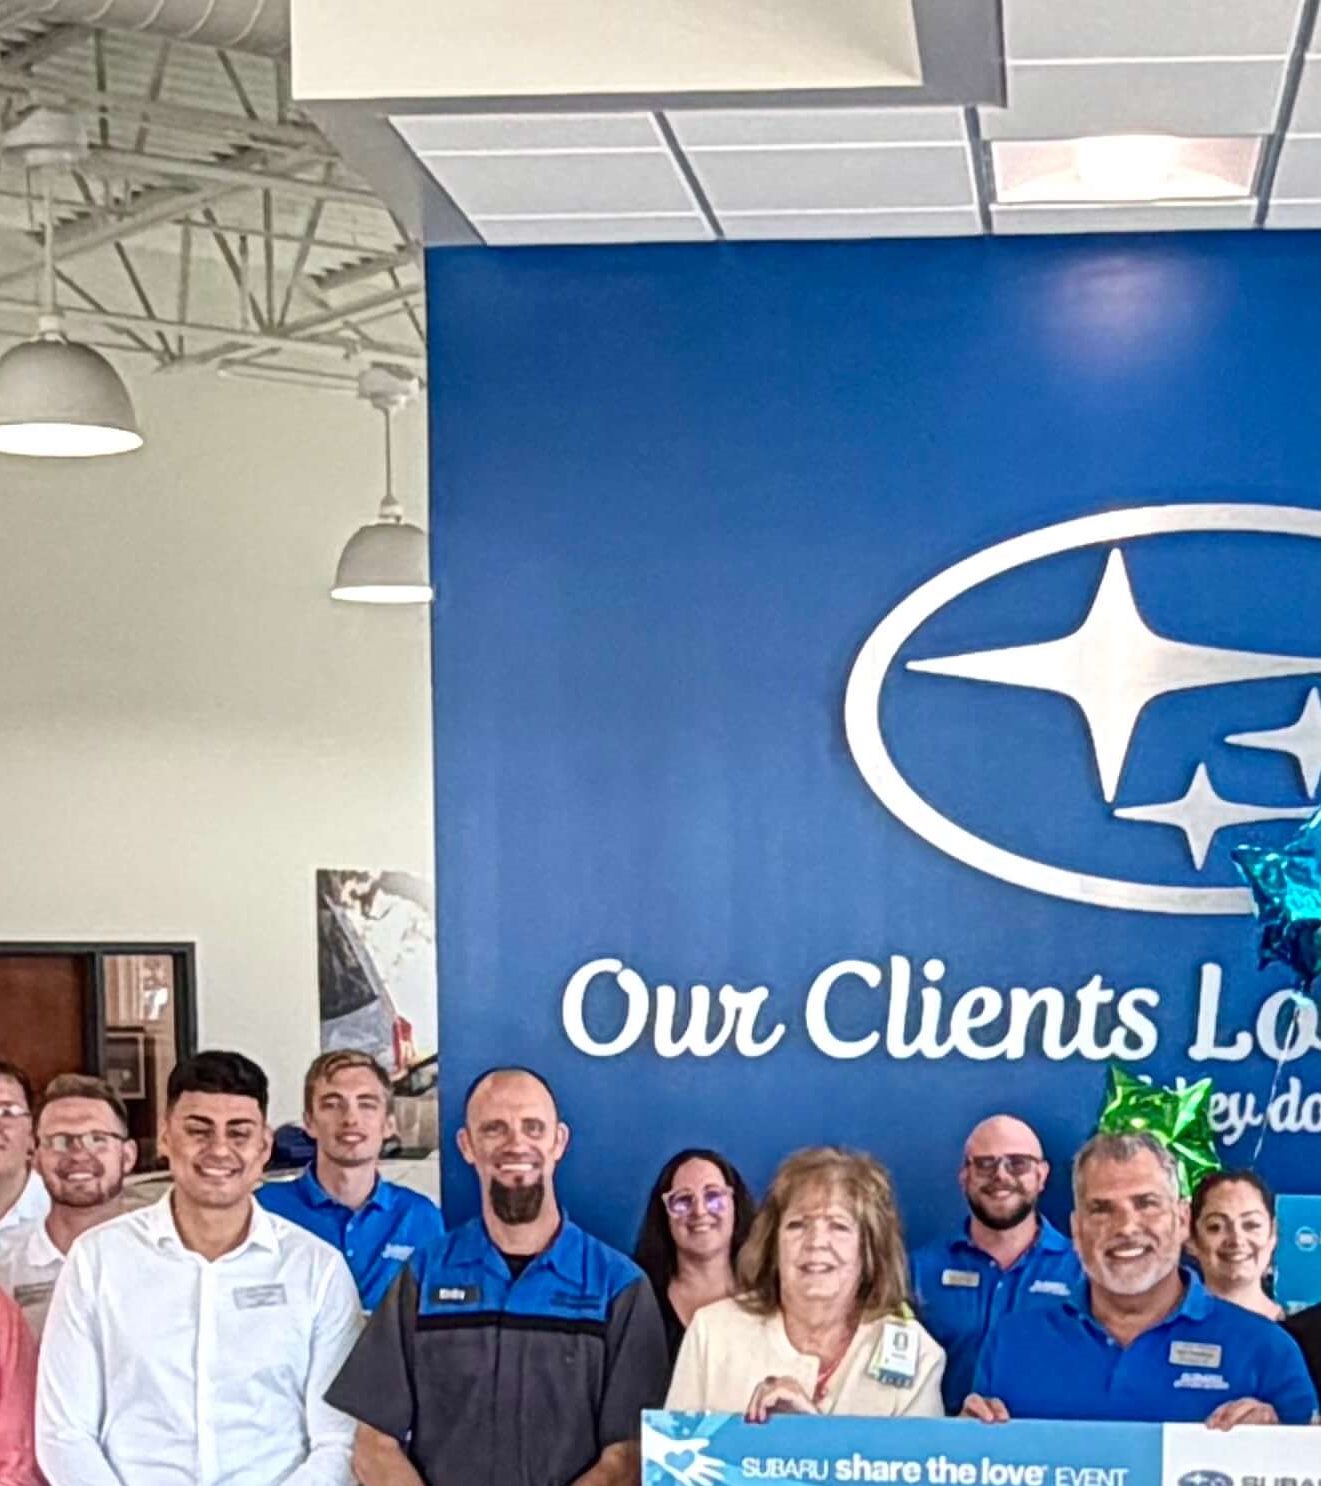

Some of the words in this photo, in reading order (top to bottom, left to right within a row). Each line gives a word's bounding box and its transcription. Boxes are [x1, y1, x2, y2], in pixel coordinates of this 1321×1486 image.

[561, 957, 787, 1059] Our
[804, 953, 1161, 1060] Clients
[1163, 1076, 1264, 1146] ey
[742, 1457, 829, 1481] SUBARU
[835, 1453, 922, 1483] share
[925, 1455, 978, 1485] the
[980, 1457, 1048, 1486] love
